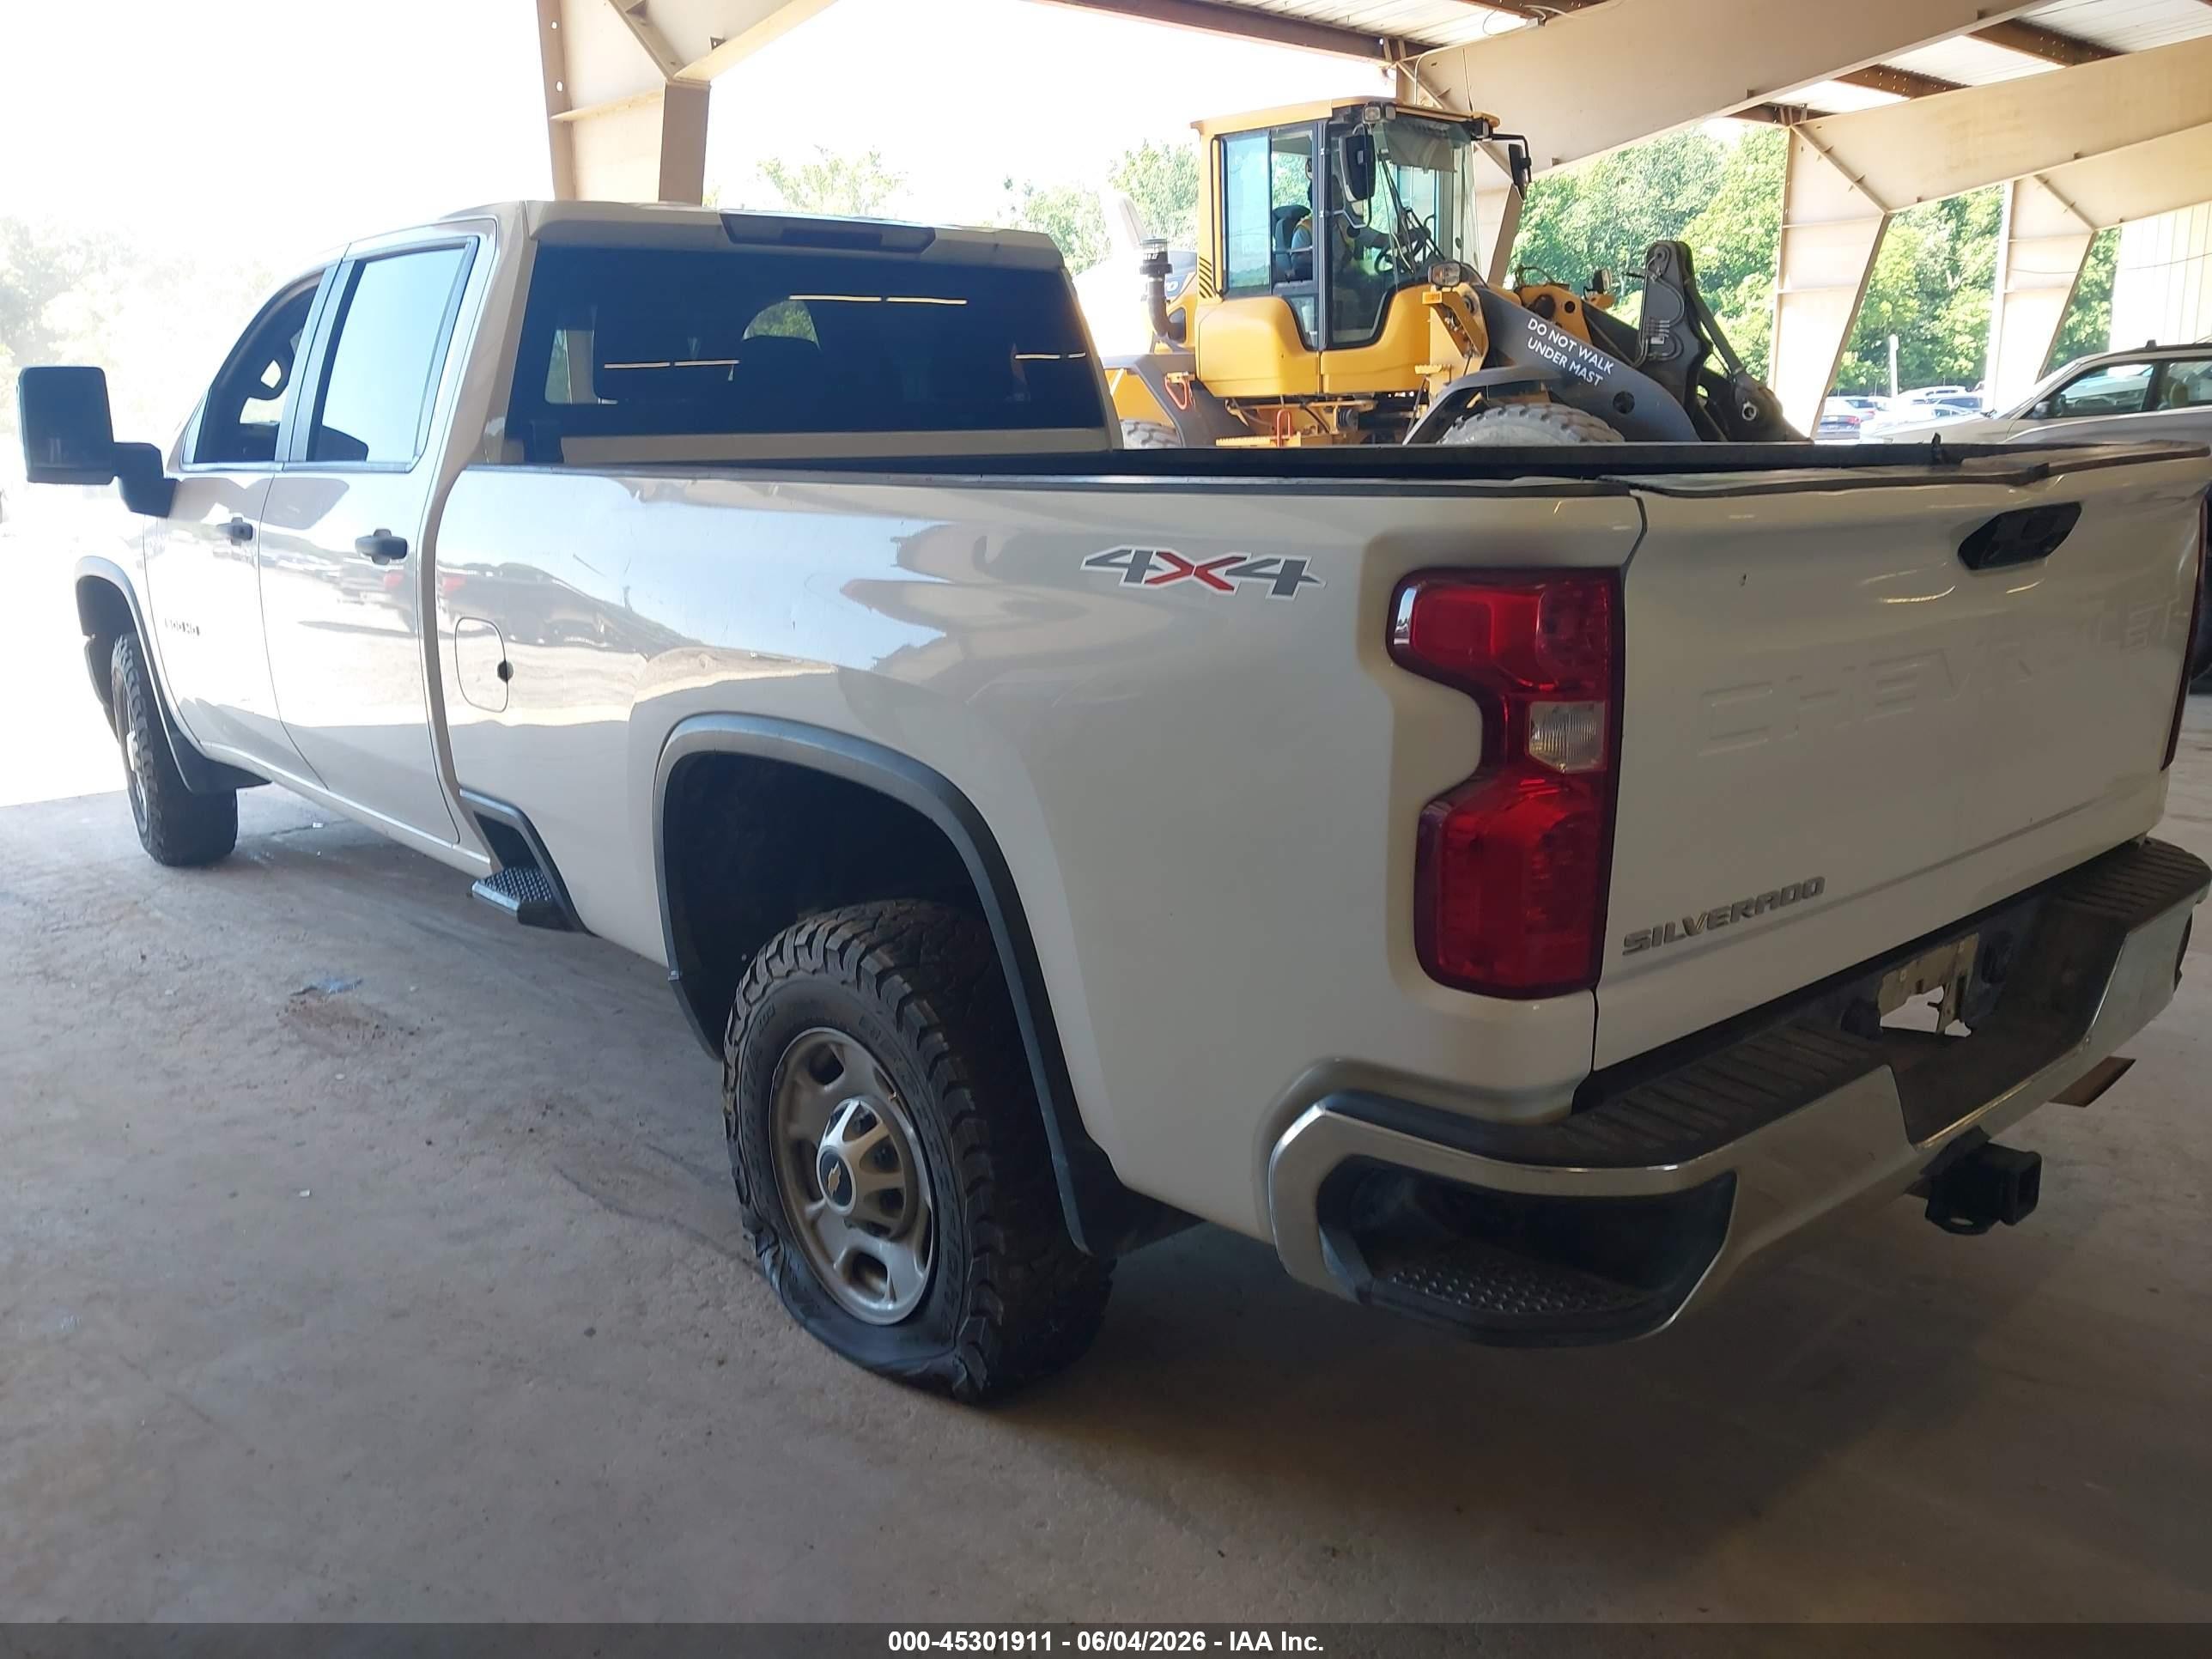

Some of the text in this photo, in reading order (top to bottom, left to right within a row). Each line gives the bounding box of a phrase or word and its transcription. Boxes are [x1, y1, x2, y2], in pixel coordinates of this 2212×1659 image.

[1527, 318, 1614, 375] DO NOT WALK
[1527, 337, 1603, 386] UNDER MAST
[1079, 544, 1327, 600] 4X4
[1622, 876, 1826, 956] SILVERADO
